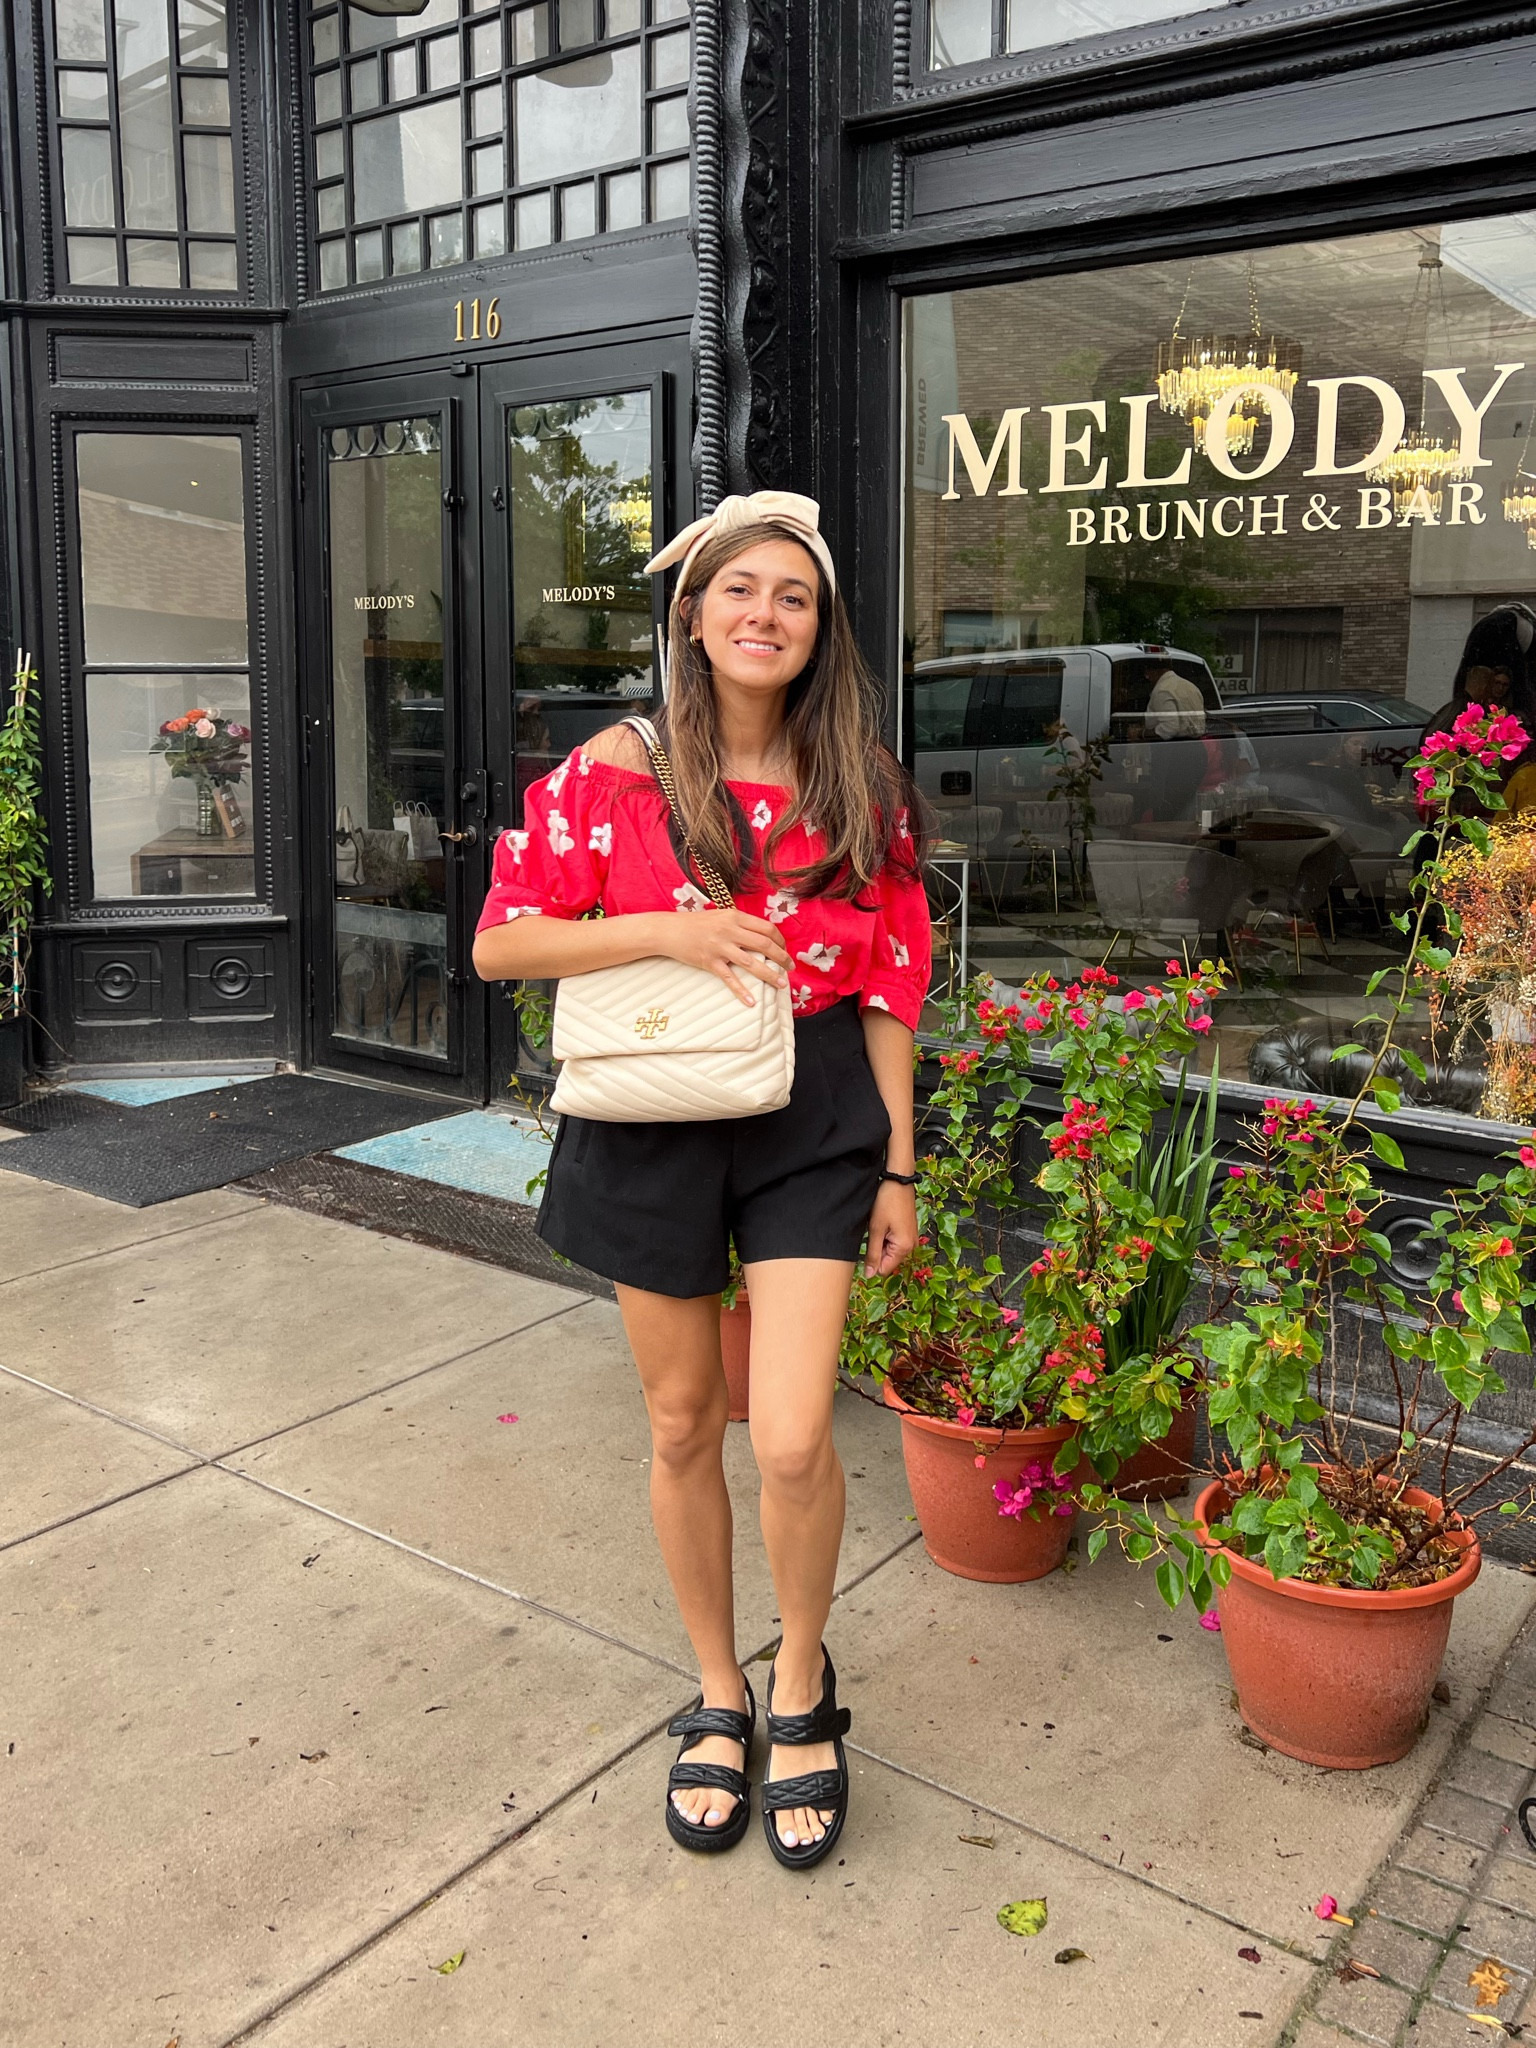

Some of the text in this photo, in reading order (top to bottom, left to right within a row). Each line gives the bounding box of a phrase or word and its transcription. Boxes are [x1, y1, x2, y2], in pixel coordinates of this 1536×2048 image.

[453, 297, 502, 342] 116
[941, 363, 1525, 500] MELODY
[1066, 483, 1487, 546] BRUNCH & BAR
[354, 595, 415, 610] MELODY'S
[542, 585, 615, 603] MELODY'S
